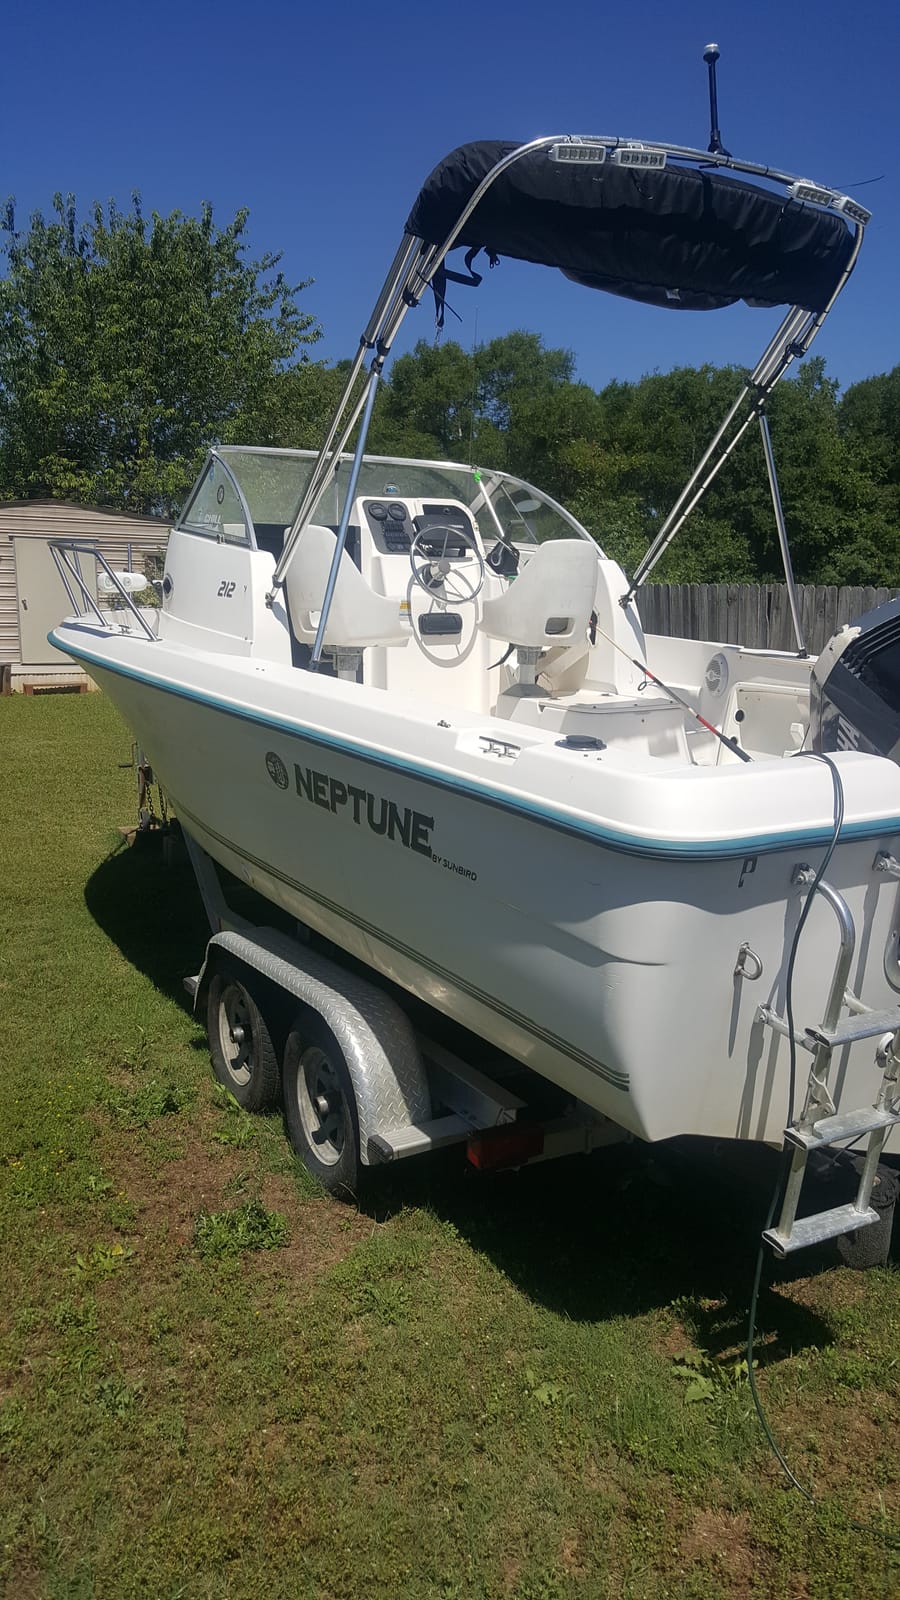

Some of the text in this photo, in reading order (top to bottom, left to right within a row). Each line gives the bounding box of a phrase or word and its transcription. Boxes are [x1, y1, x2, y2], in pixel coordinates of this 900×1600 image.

[217, 580, 236, 598] 212
[293, 763, 435, 858] NEPTUNE
[432, 854, 477, 881] BY SUNBIRD
